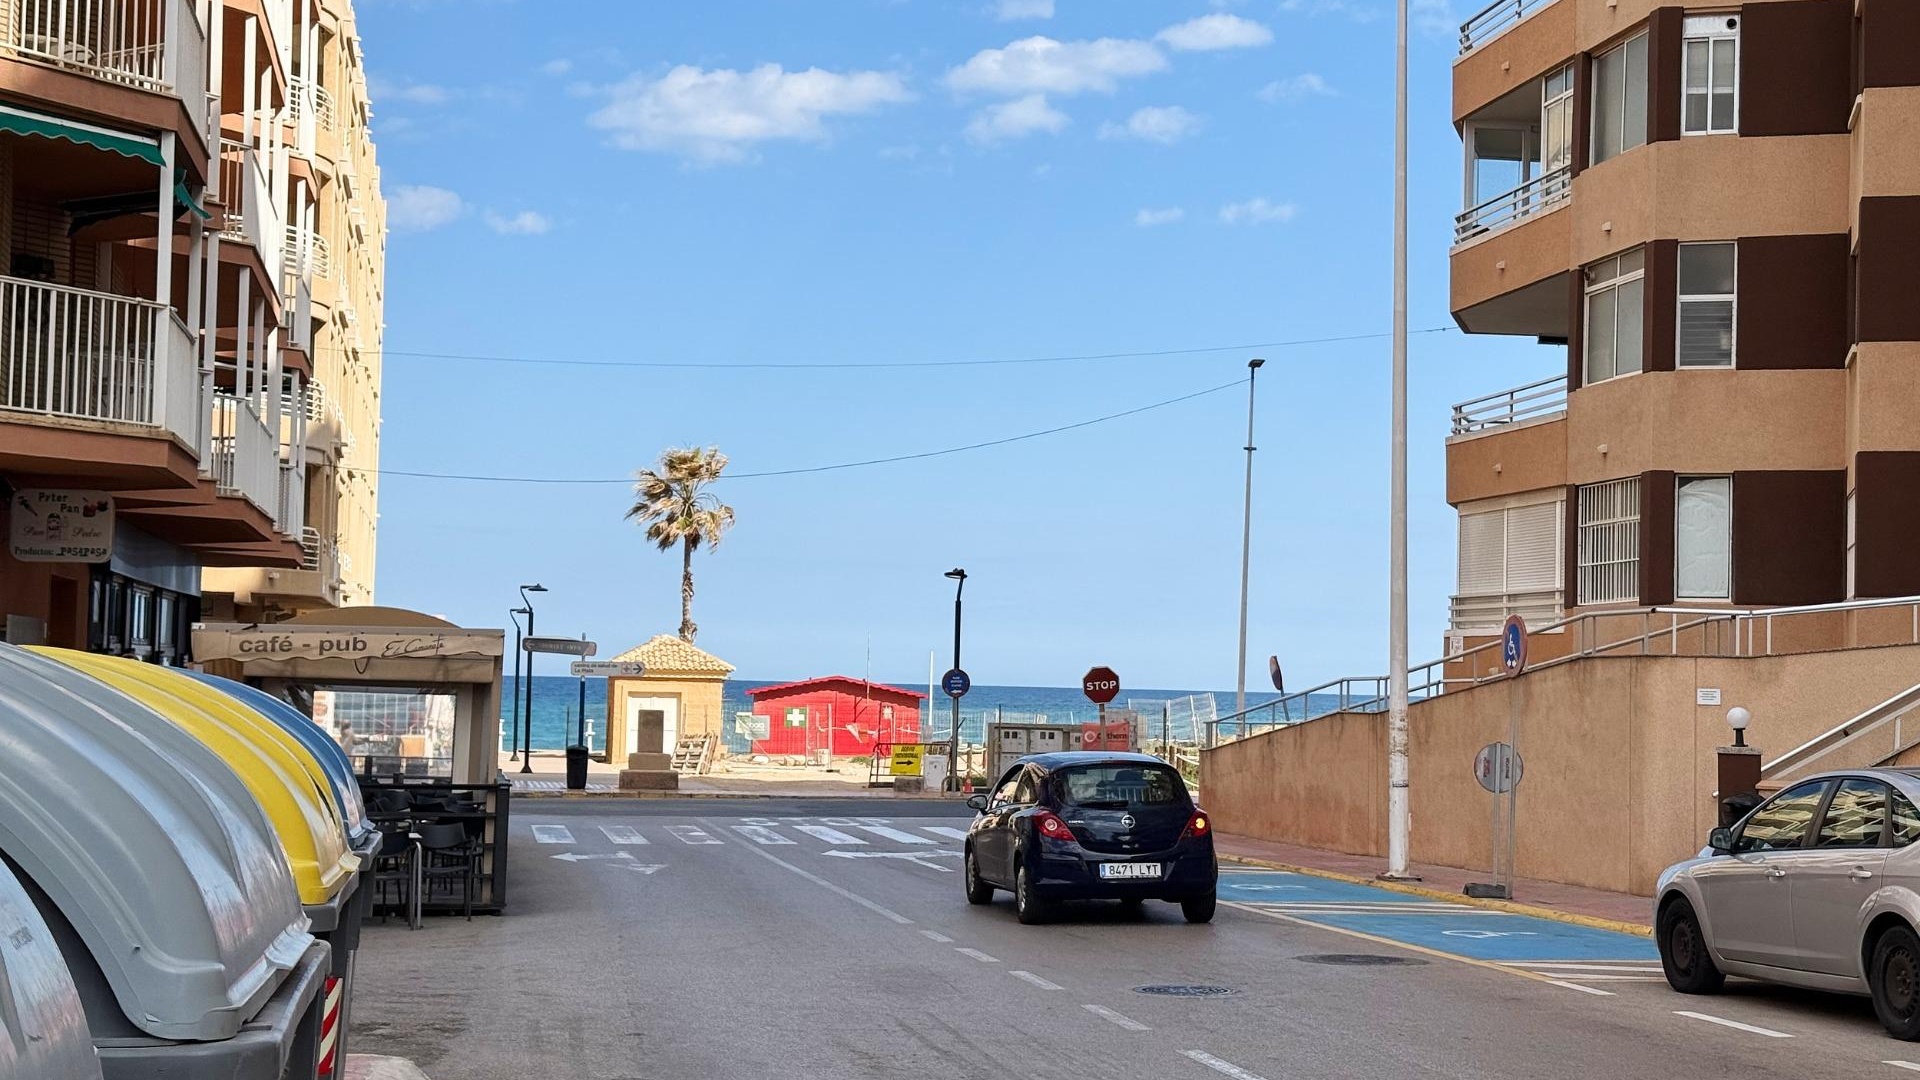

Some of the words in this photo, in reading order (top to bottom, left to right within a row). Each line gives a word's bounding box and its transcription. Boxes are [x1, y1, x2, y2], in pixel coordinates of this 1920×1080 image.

[38, 491, 69, 503] Pyter
[60, 503, 80, 514] Pan
[238, 635, 293, 653] café
[319, 636, 368, 655] pub
[1086, 680, 1117, 691] STOP
[1109, 864, 1134, 876] 8471
[1139, 864, 1158, 876] LYT
